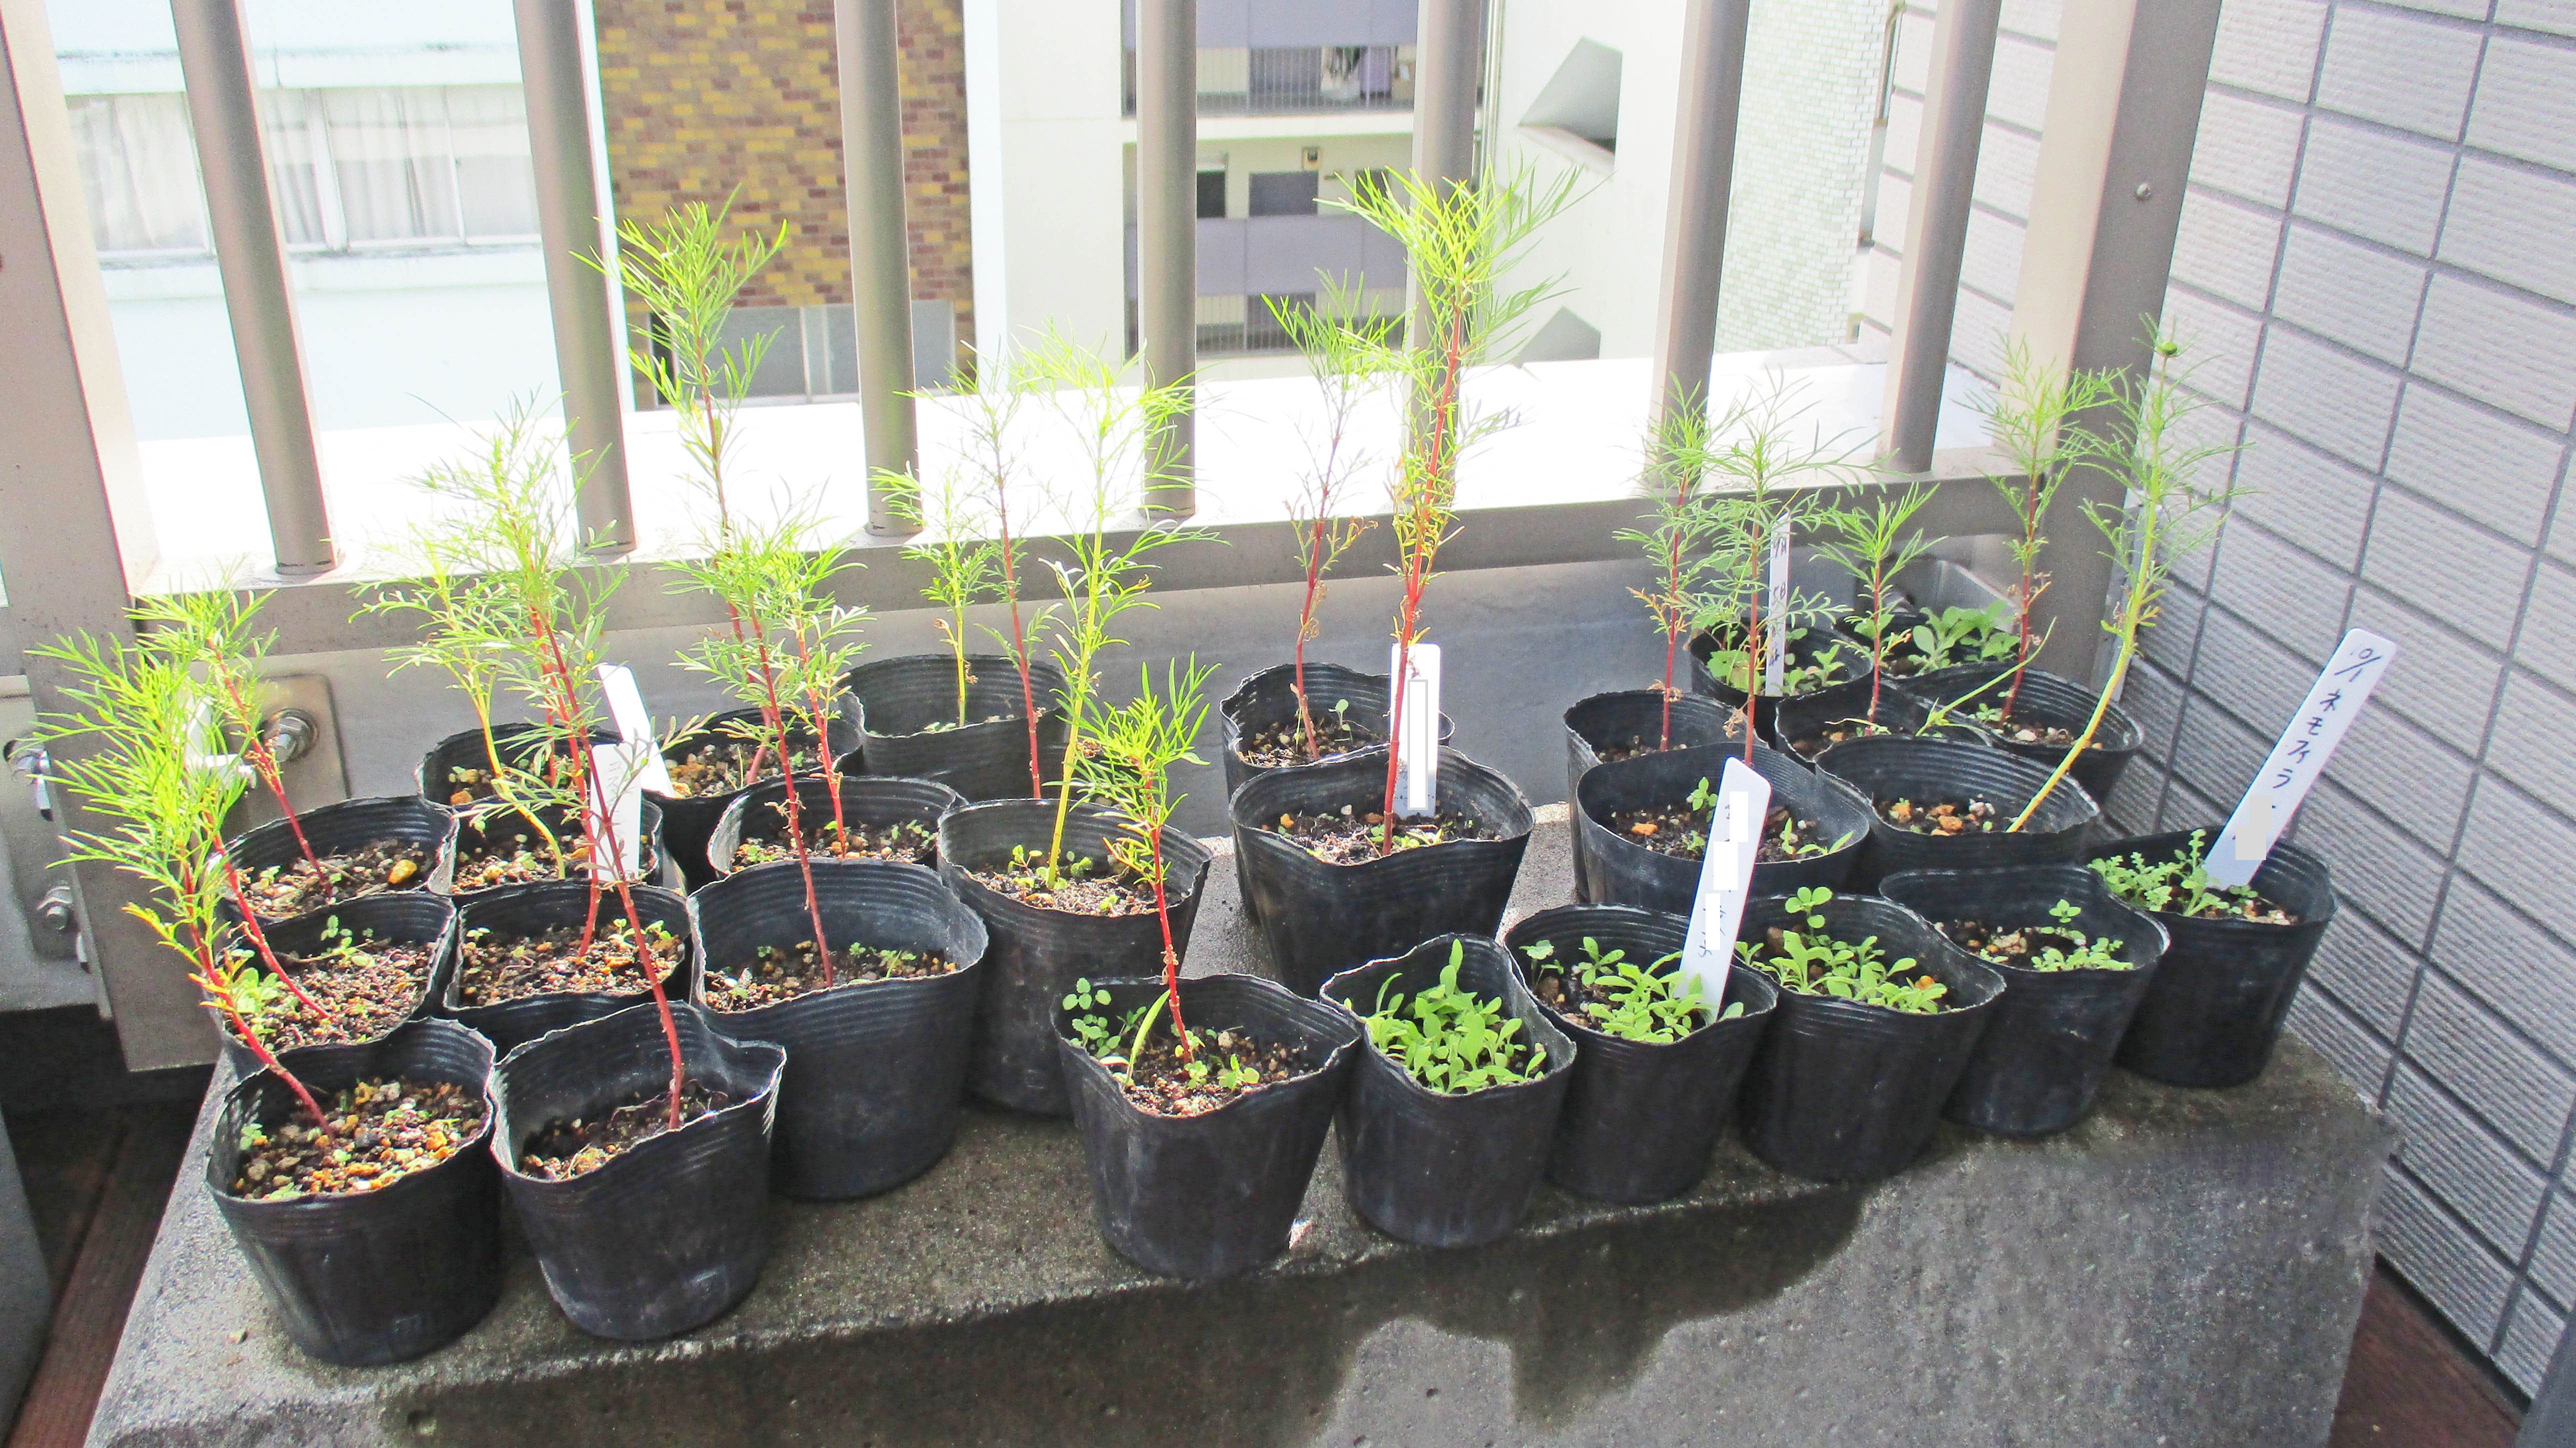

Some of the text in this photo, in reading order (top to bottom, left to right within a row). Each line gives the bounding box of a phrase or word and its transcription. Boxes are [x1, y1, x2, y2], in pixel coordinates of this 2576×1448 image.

[2272, 688, 2342, 789] ネモフィラ
